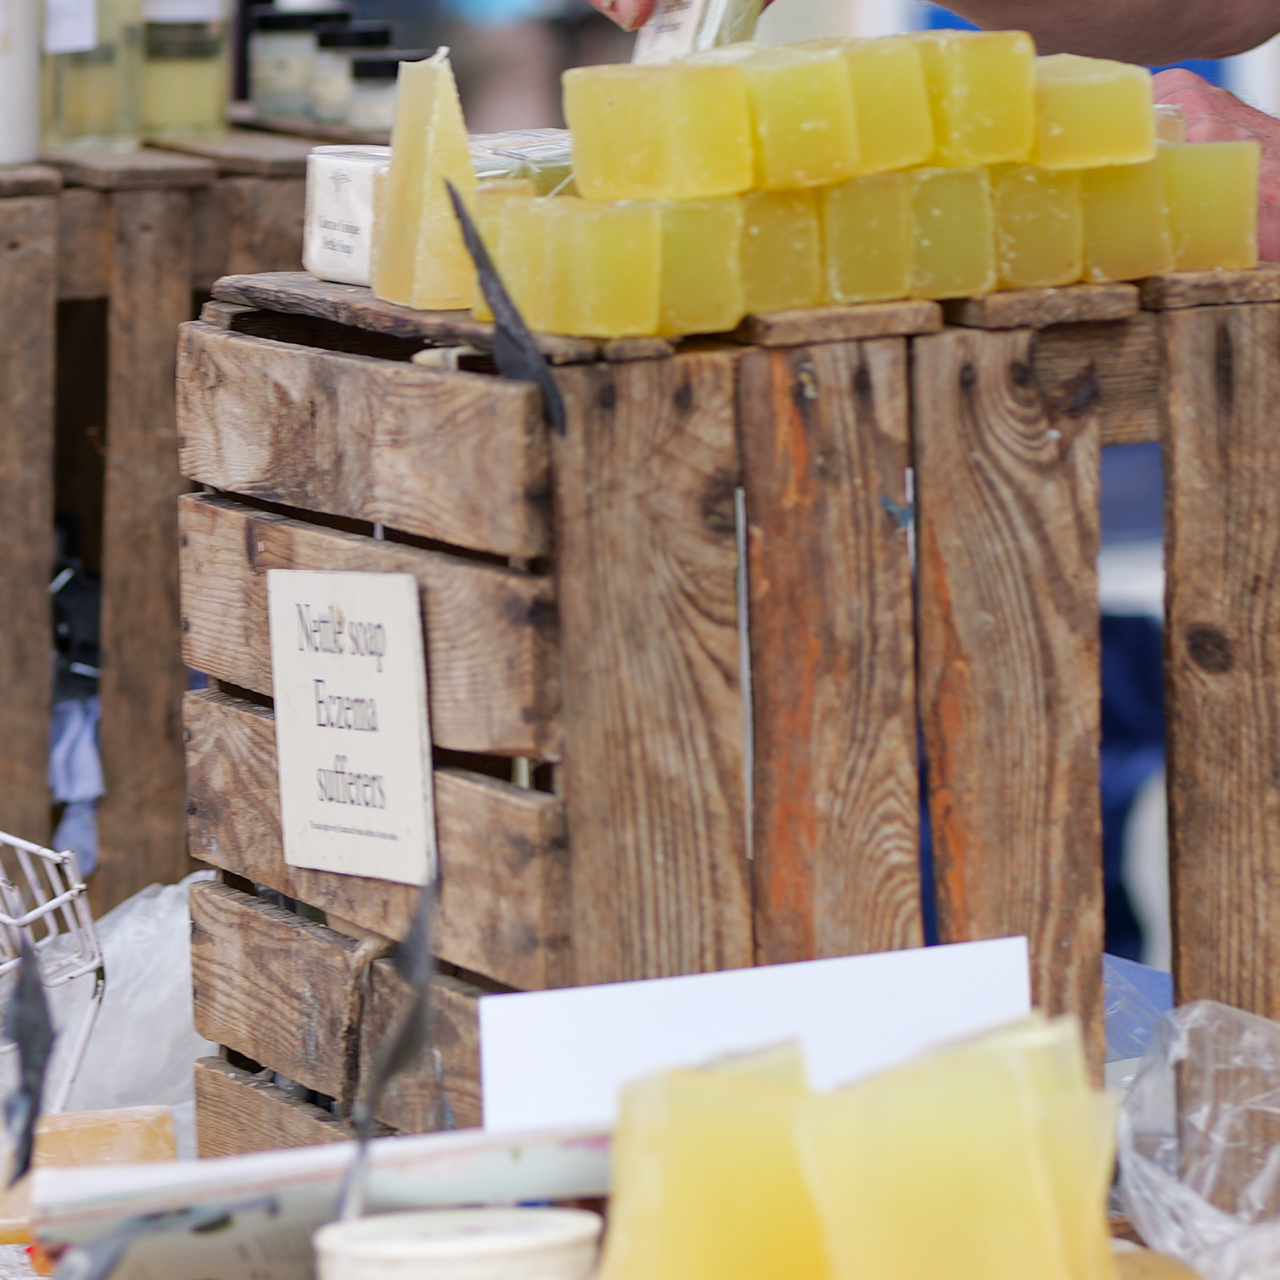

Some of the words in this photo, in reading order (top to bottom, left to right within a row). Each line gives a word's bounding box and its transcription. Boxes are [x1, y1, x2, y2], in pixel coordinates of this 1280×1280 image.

[295, 603, 345, 655] Nettle
[348, 620, 386, 673] soap
[313, 678, 379, 732] Eczema
[316, 754, 387, 810] sufferers
